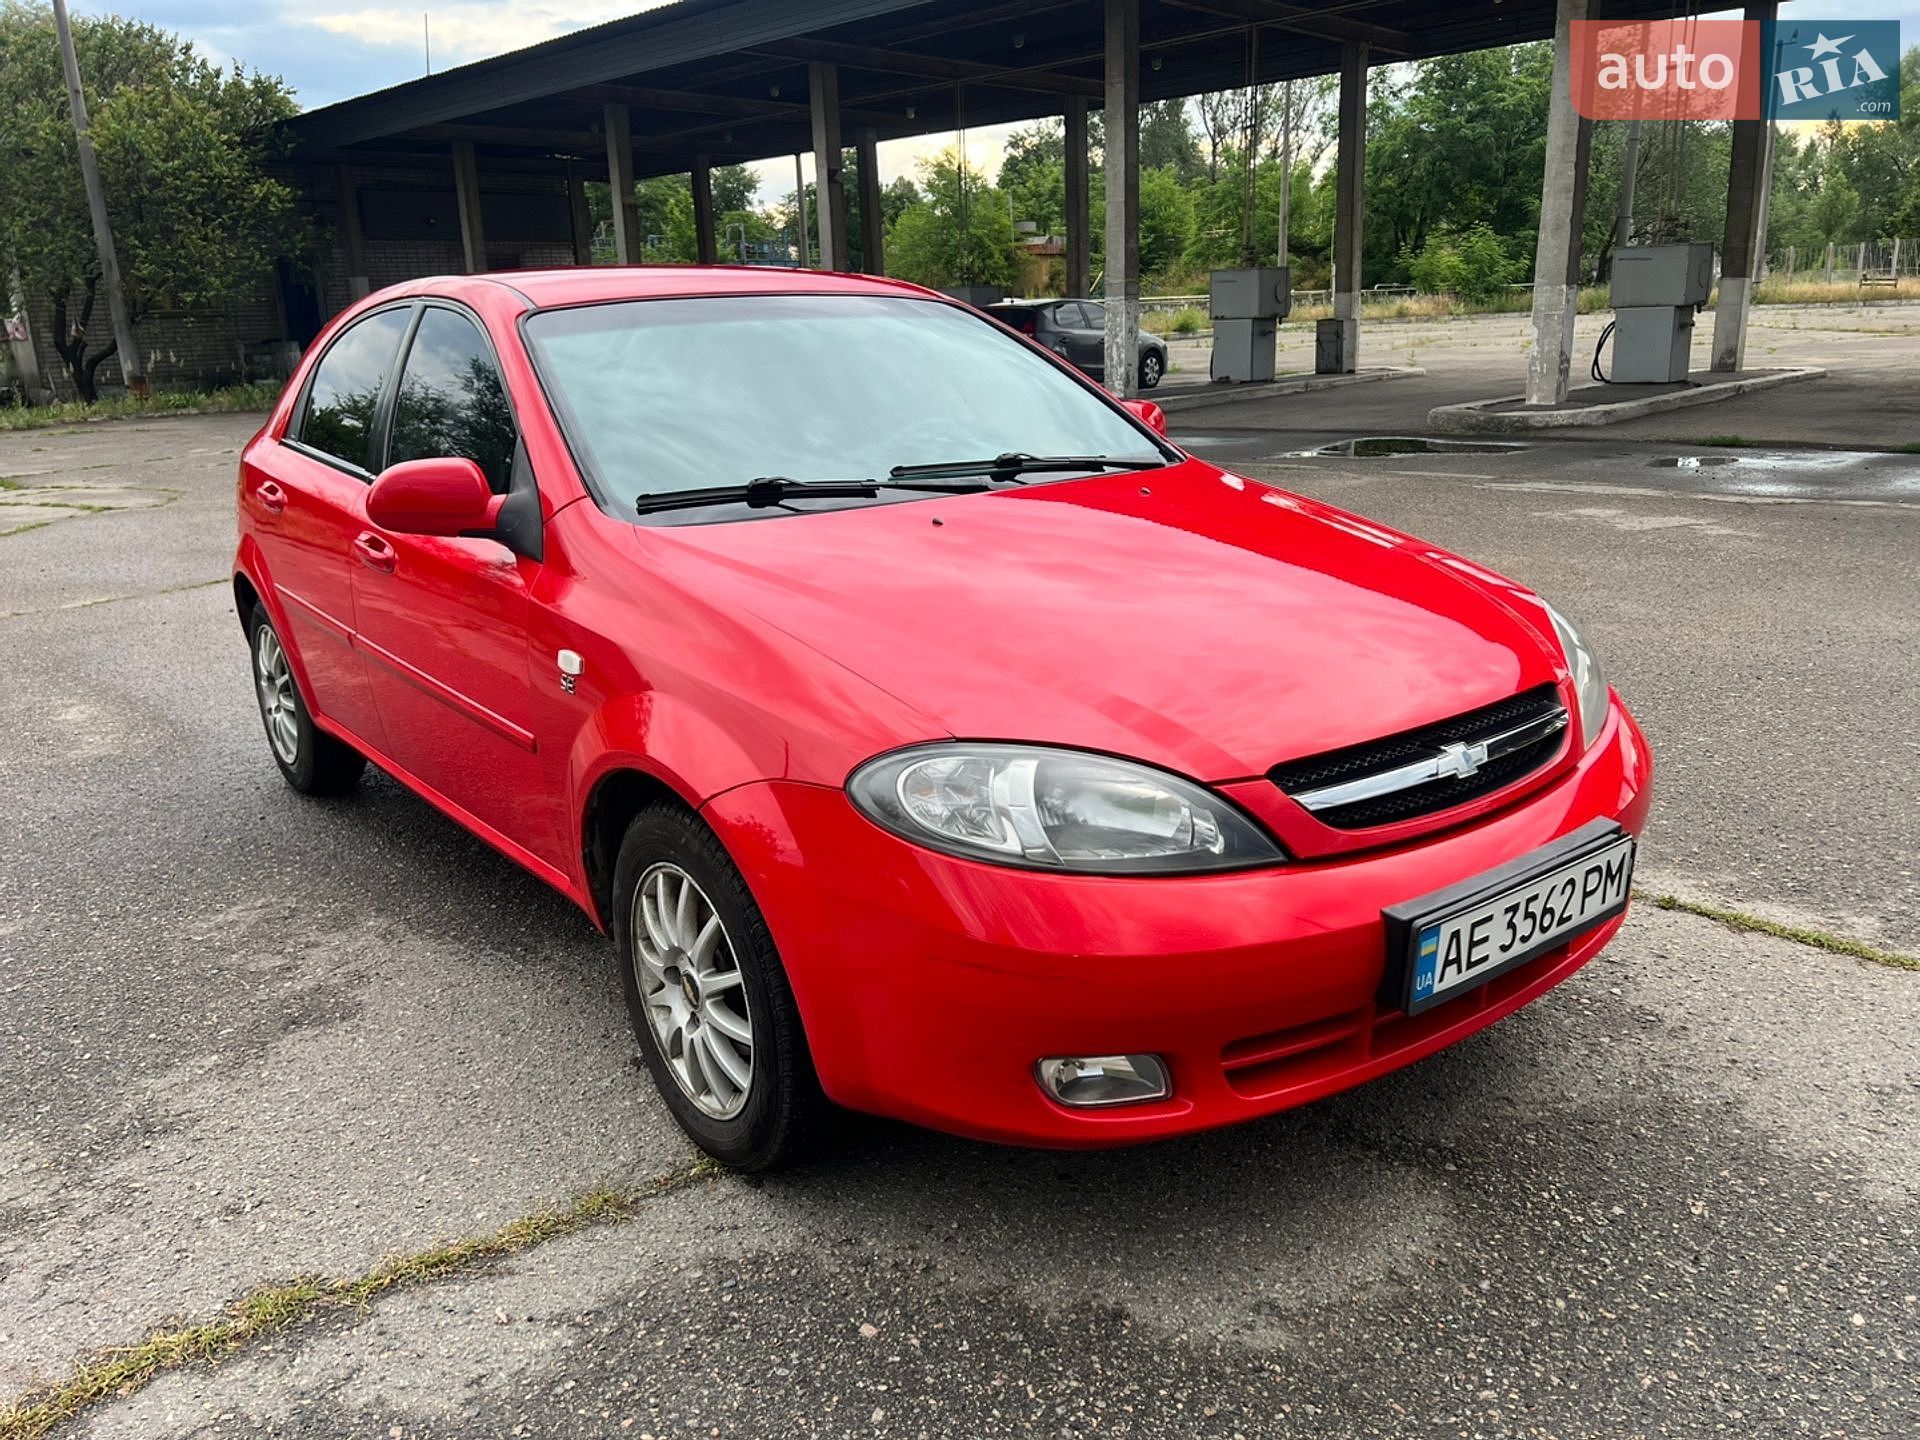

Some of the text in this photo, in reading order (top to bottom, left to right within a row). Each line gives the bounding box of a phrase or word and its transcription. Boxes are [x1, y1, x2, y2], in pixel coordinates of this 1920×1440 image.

[1438, 914, 1494, 983] AE
[1499, 877, 1577, 953] 3562
[1416, 971, 1434, 991] UA
